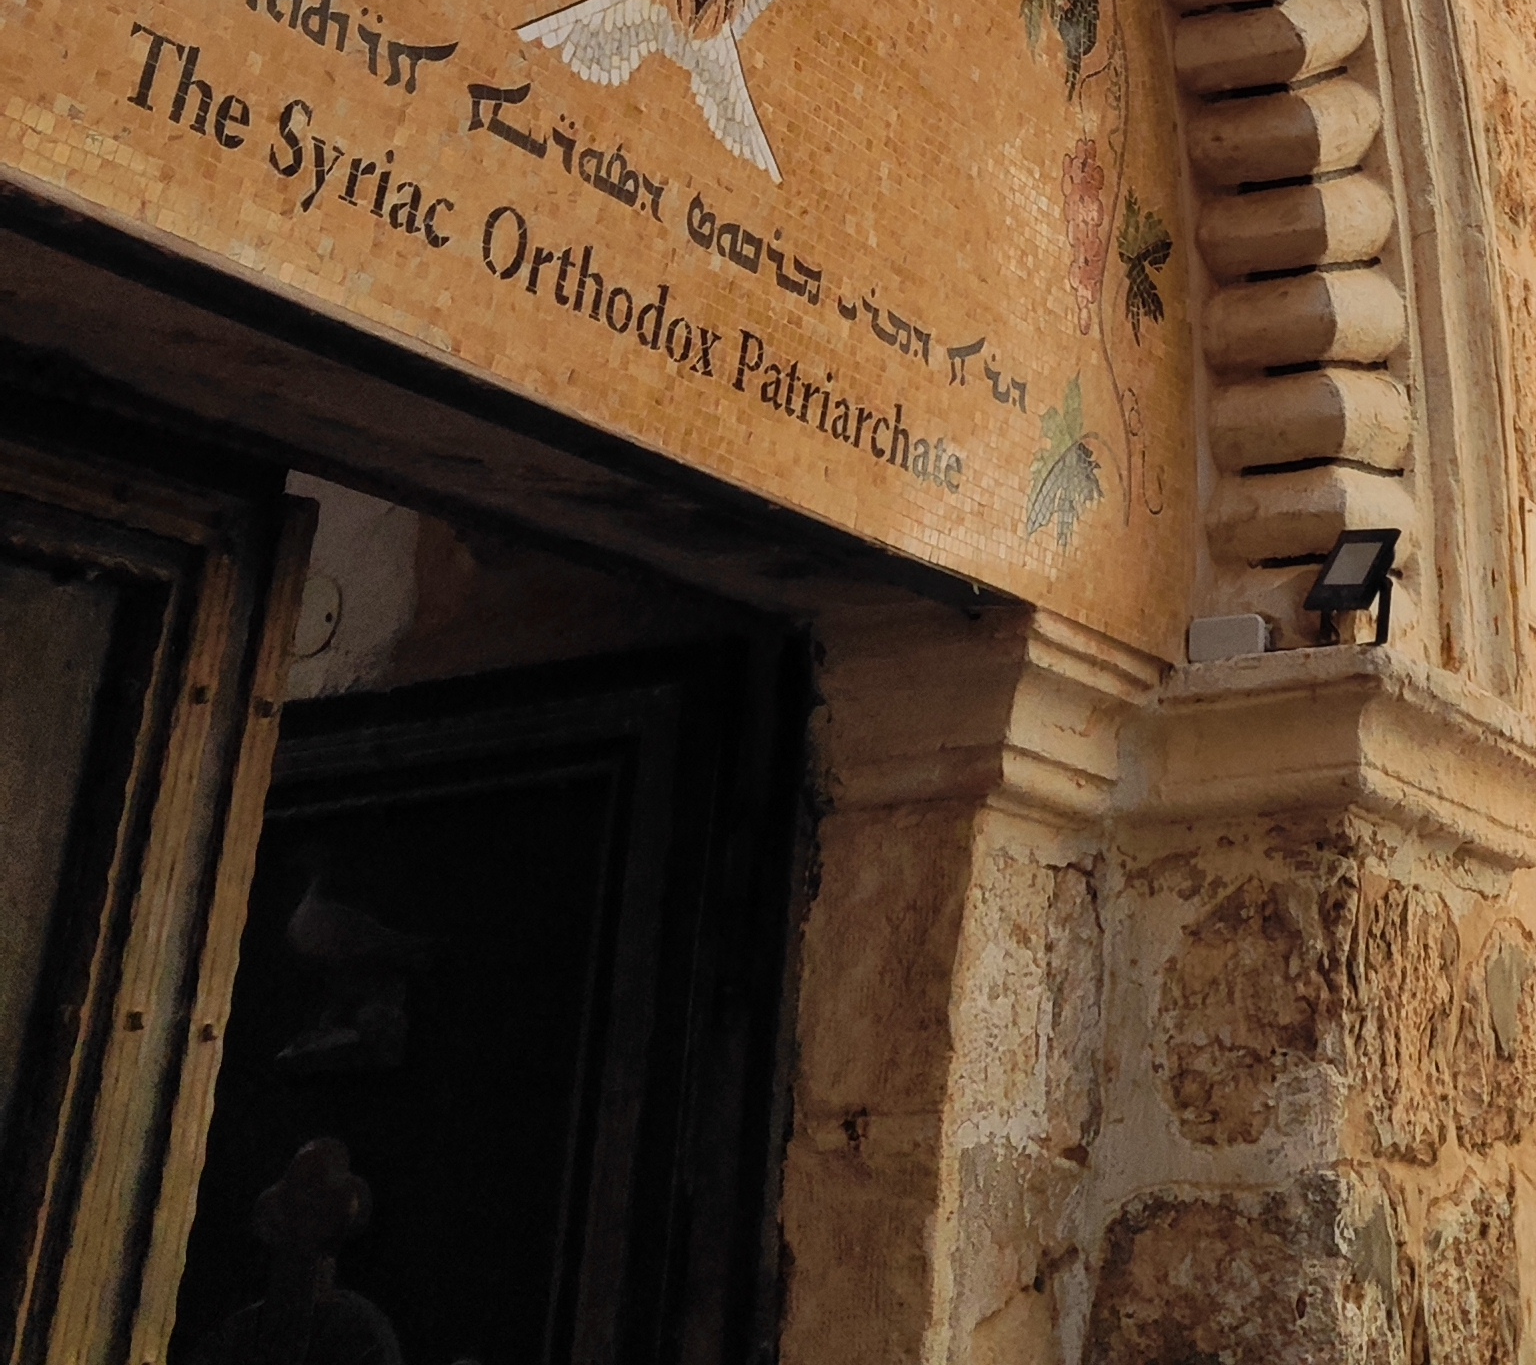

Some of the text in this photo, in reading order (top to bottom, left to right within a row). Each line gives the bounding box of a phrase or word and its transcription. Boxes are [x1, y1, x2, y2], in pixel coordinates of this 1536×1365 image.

[127, 21, 964, 494] The Syriac Orthodox Patriarchate
